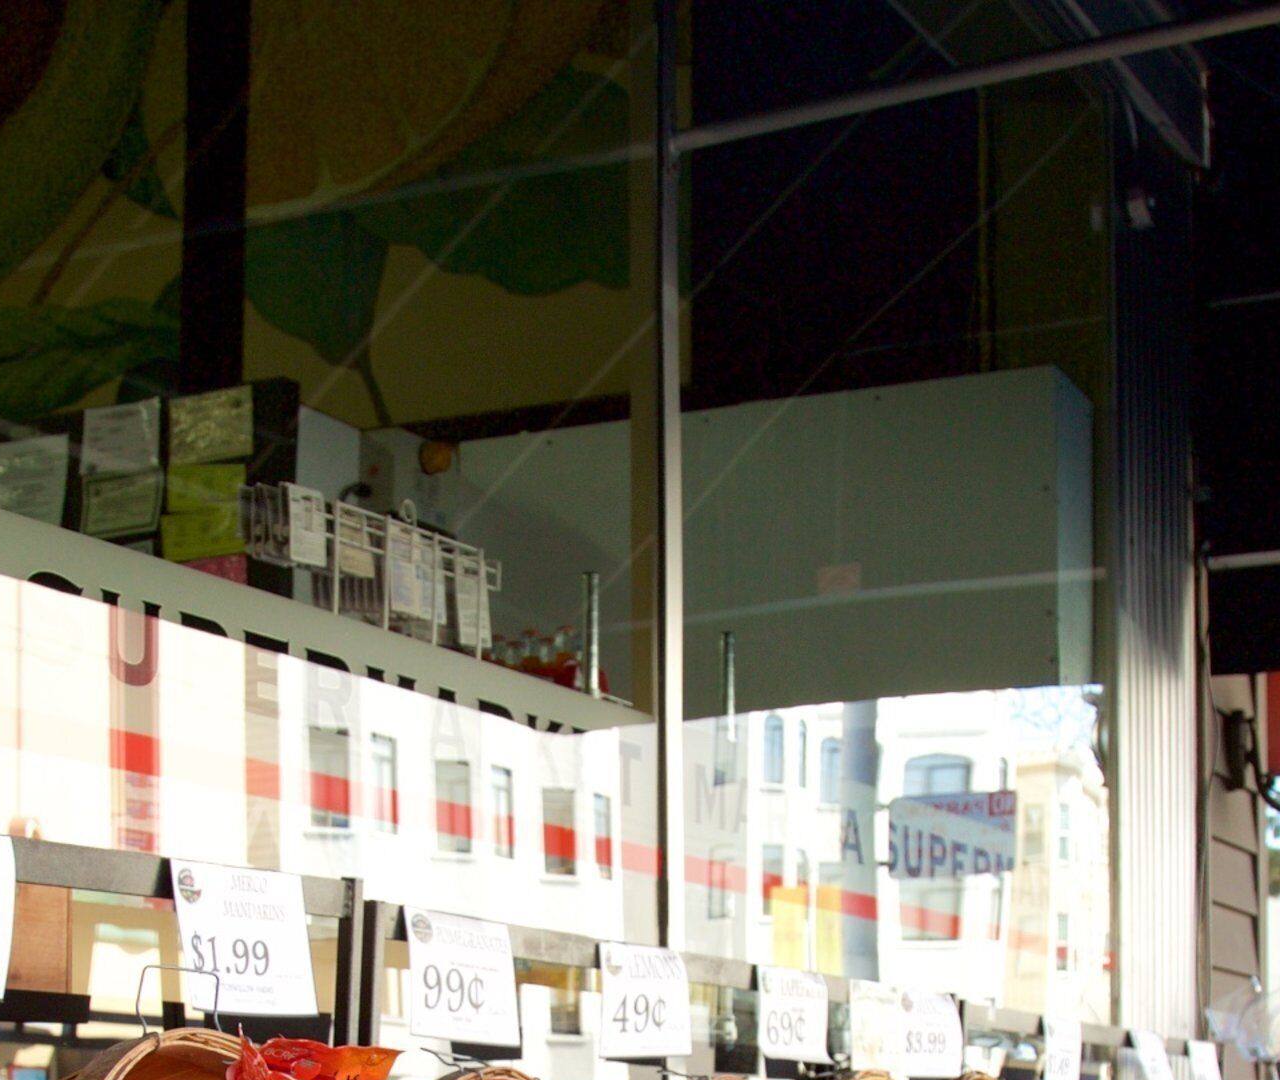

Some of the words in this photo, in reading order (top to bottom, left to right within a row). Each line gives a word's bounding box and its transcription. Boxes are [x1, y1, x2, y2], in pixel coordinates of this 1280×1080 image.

[223, 899, 288, 923] MANDARINS
[191, 930, 270, 977] $1.99
[422, 963, 485, 1015] 99¢
[611, 993, 668, 1034] 49¢
[766, 1010, 807, 1047] 69¢
[905, 1031, 947, 1054] $3.99
